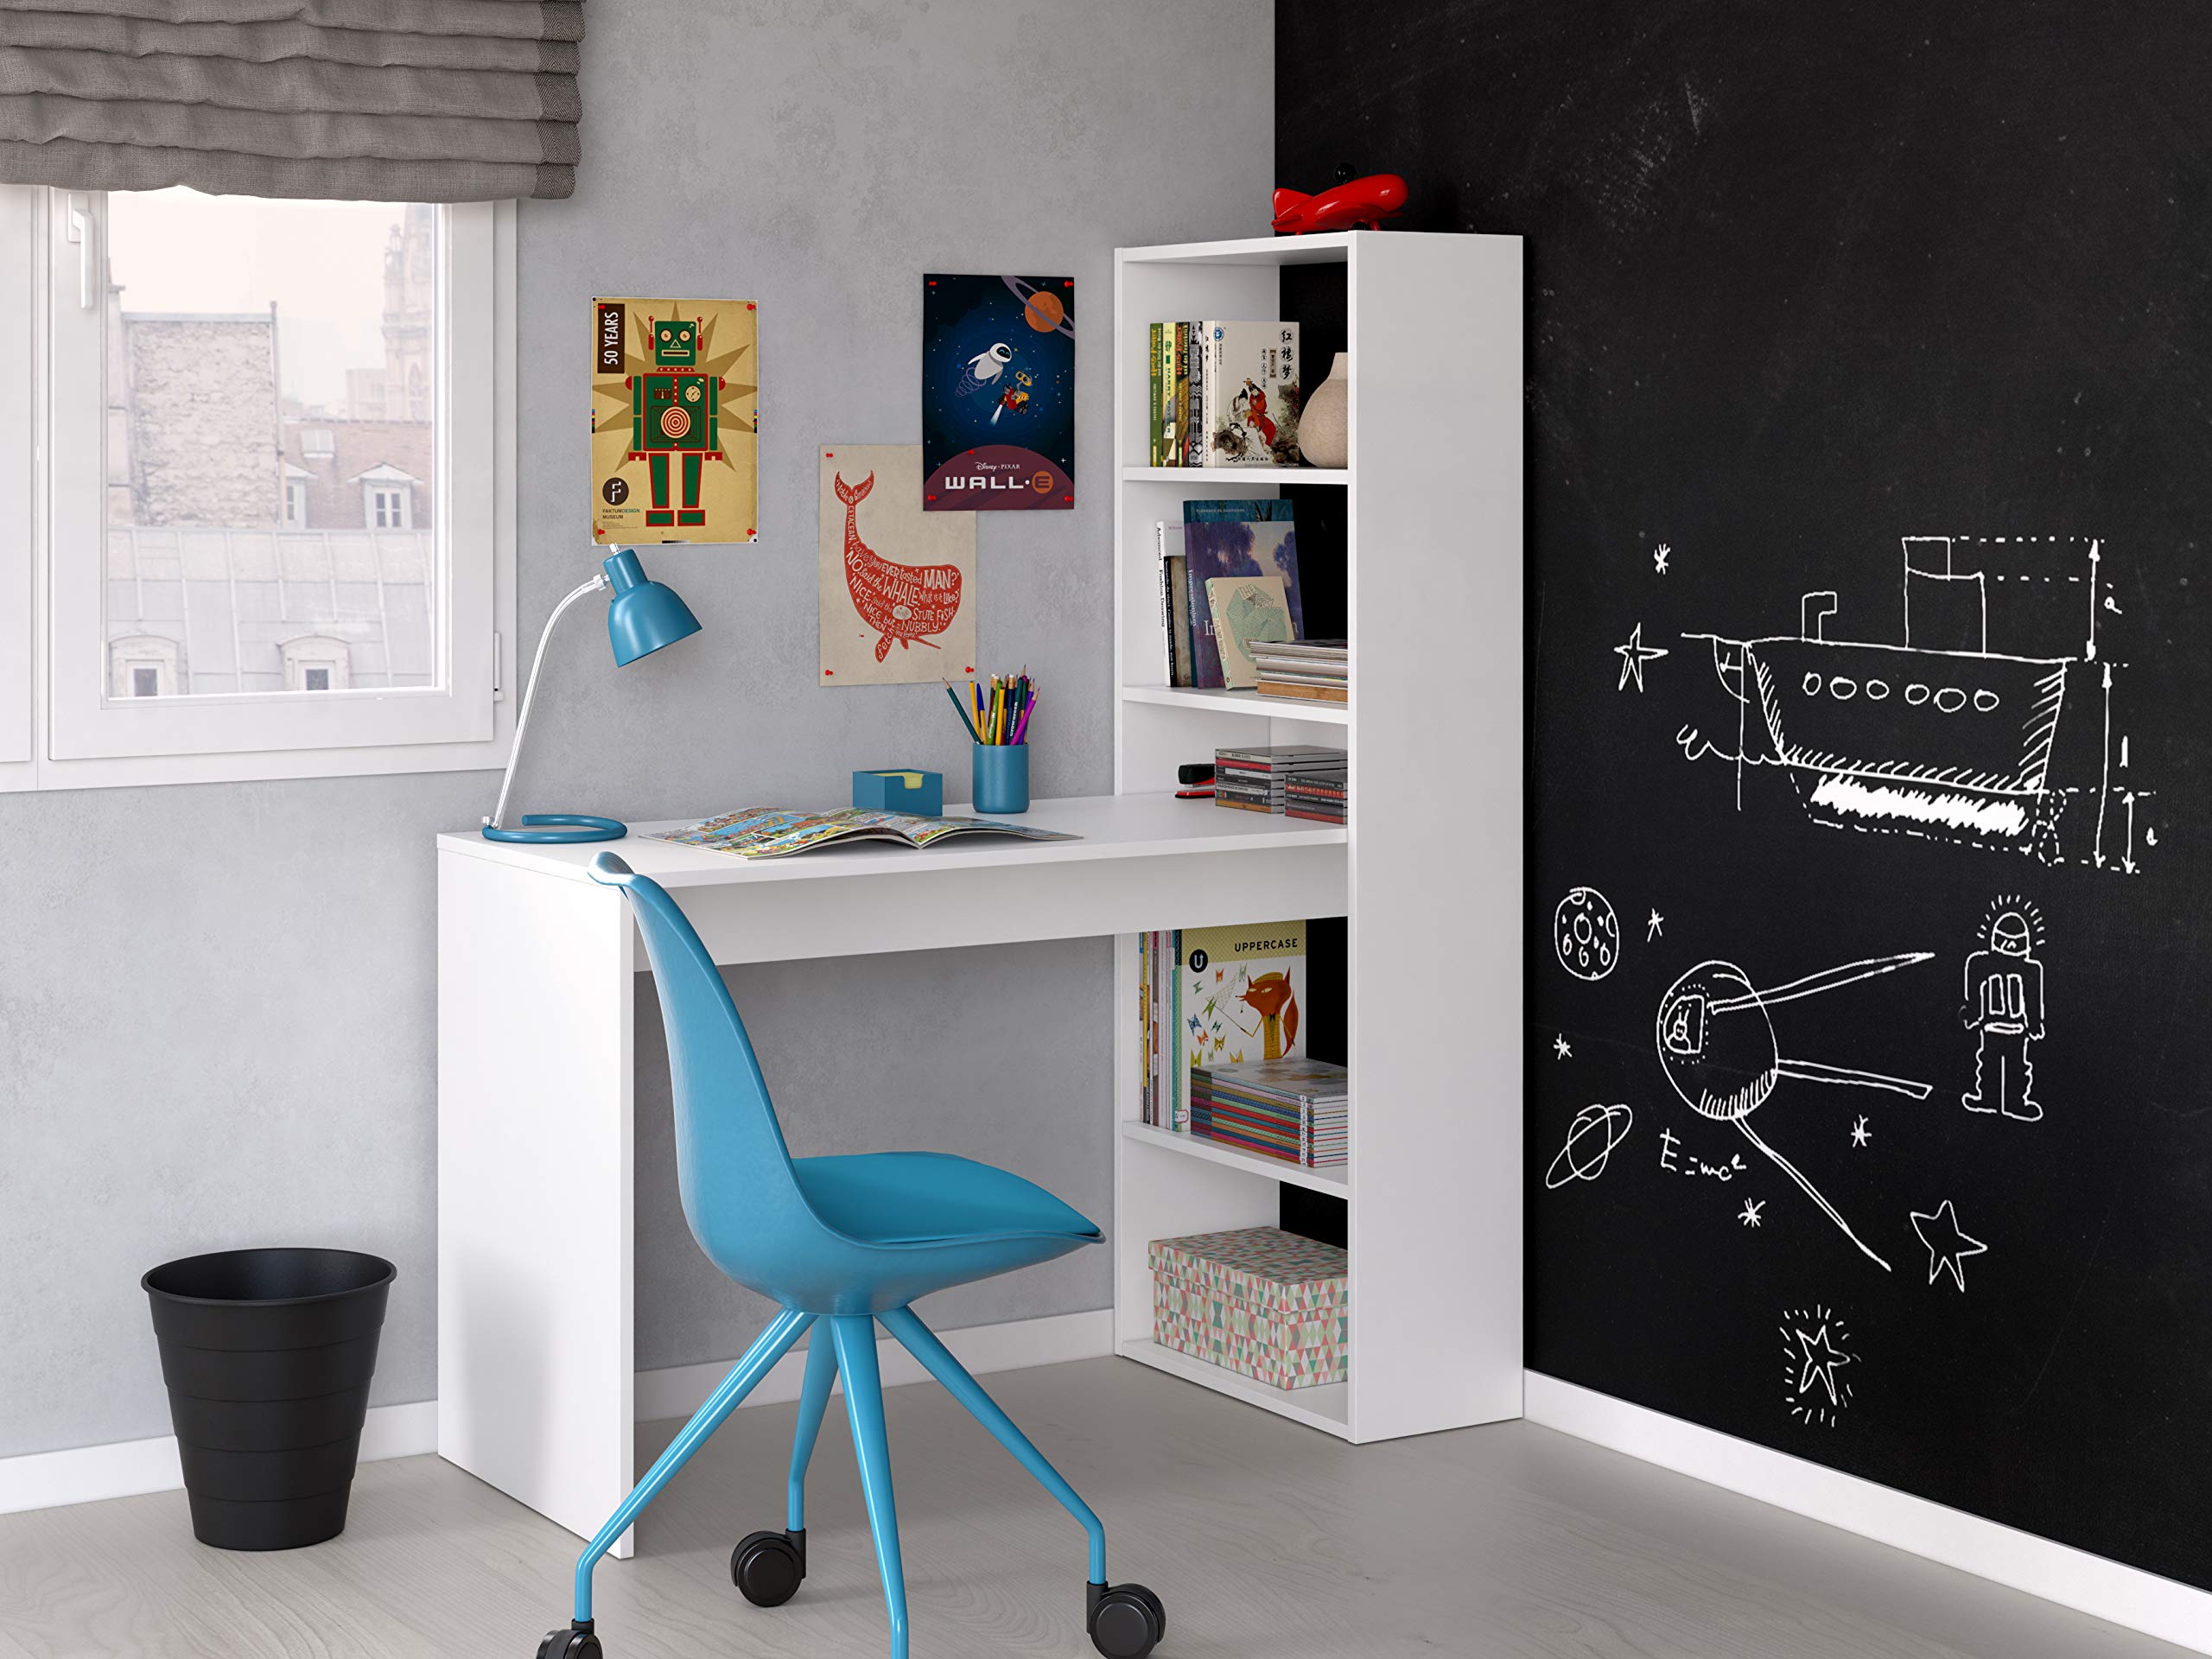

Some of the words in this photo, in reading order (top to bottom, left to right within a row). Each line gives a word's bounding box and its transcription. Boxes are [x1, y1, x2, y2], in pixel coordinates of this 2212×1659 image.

[604, 311, 619, 346] YEARS
[604, 352, 619, 365] 50
[975, 461, 997, 472] Disney
[881, 562, 900, 579] EVER
[899, 567, 923, 585] tasted
[1188, 569, 1197, 626] Impressionism
[883, 615, 896, 628] but
[1235, 938, 1298, 952] UPPERCASE
